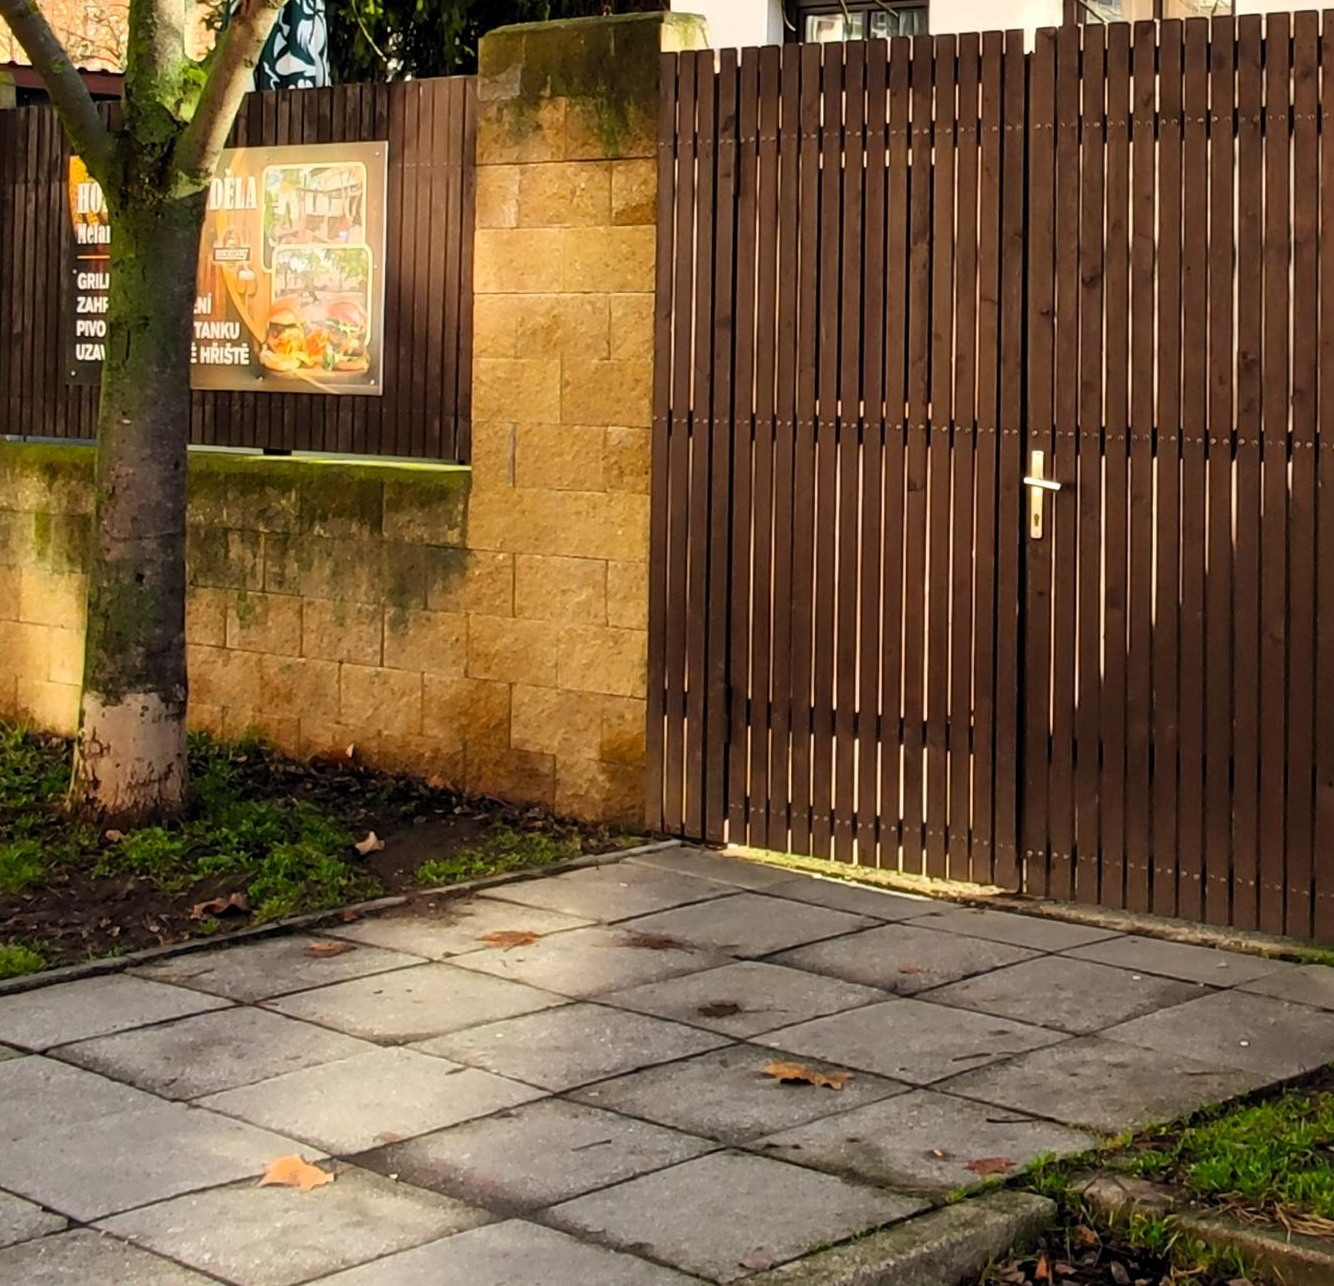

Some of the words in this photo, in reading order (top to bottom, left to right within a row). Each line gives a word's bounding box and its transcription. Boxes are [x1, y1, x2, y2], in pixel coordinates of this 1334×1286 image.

[76, 320, 107, 337] PIVO
[193, 321, 241, 340] TANKU
[199, 341, 250, 366] HŘIŠTĚ
